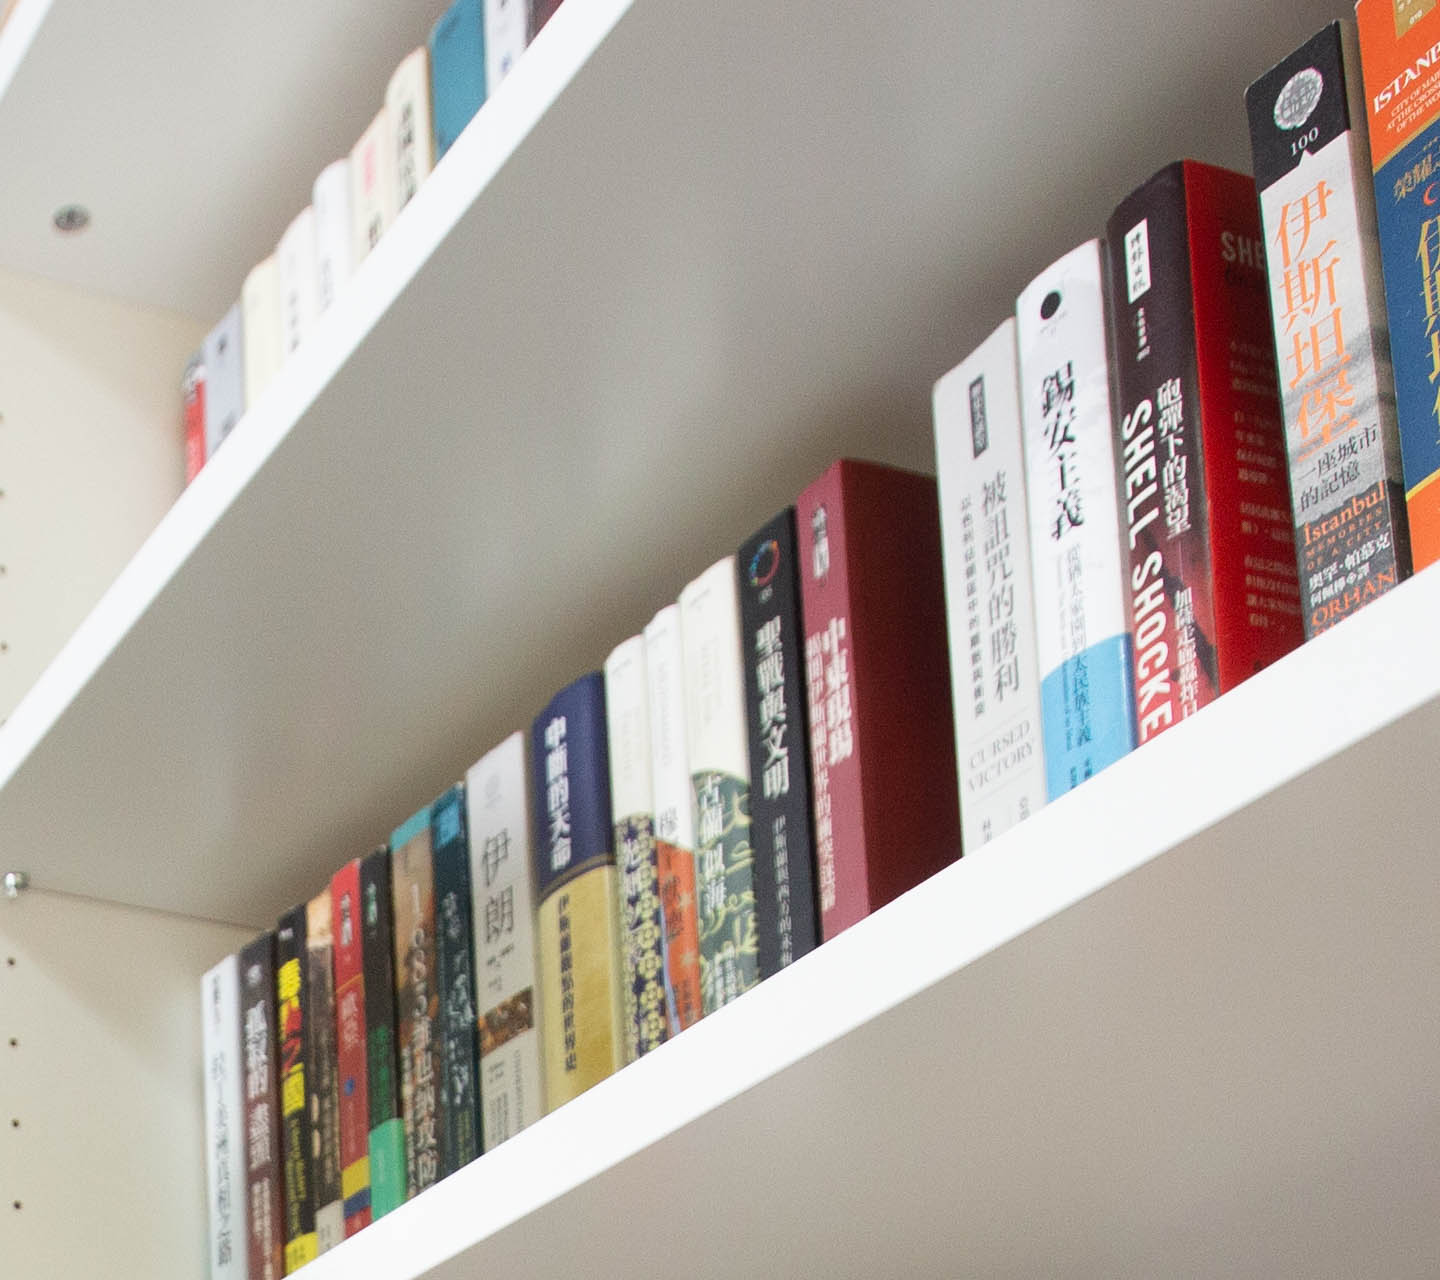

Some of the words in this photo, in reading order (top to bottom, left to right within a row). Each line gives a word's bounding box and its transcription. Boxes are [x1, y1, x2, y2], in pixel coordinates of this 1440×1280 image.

[1390, 99, 1413, 118] CITY
[1290, 126, 1320, 157] 100
[1274, 180, 1360, 463] 伊斯坦堡
[1042, 360, 1085, 541] 錫安主義
[1122, 399, 1160, 550] SHELL
[1299, 424, 1378, 480] 一座城市
[1300, 461, 1361, 512] 的記憶
[981, 470, 1020, 702] 被詛咒的勝利
[1311, 567, 1396, 627] ORHAN
[1132, 551, 1172, 741] SHOCKE
[969, 743, 1034, 790] VICTORY
[970, 720, 1030, 770] CURSED
[482, 827, 515, 942] 伊朗
